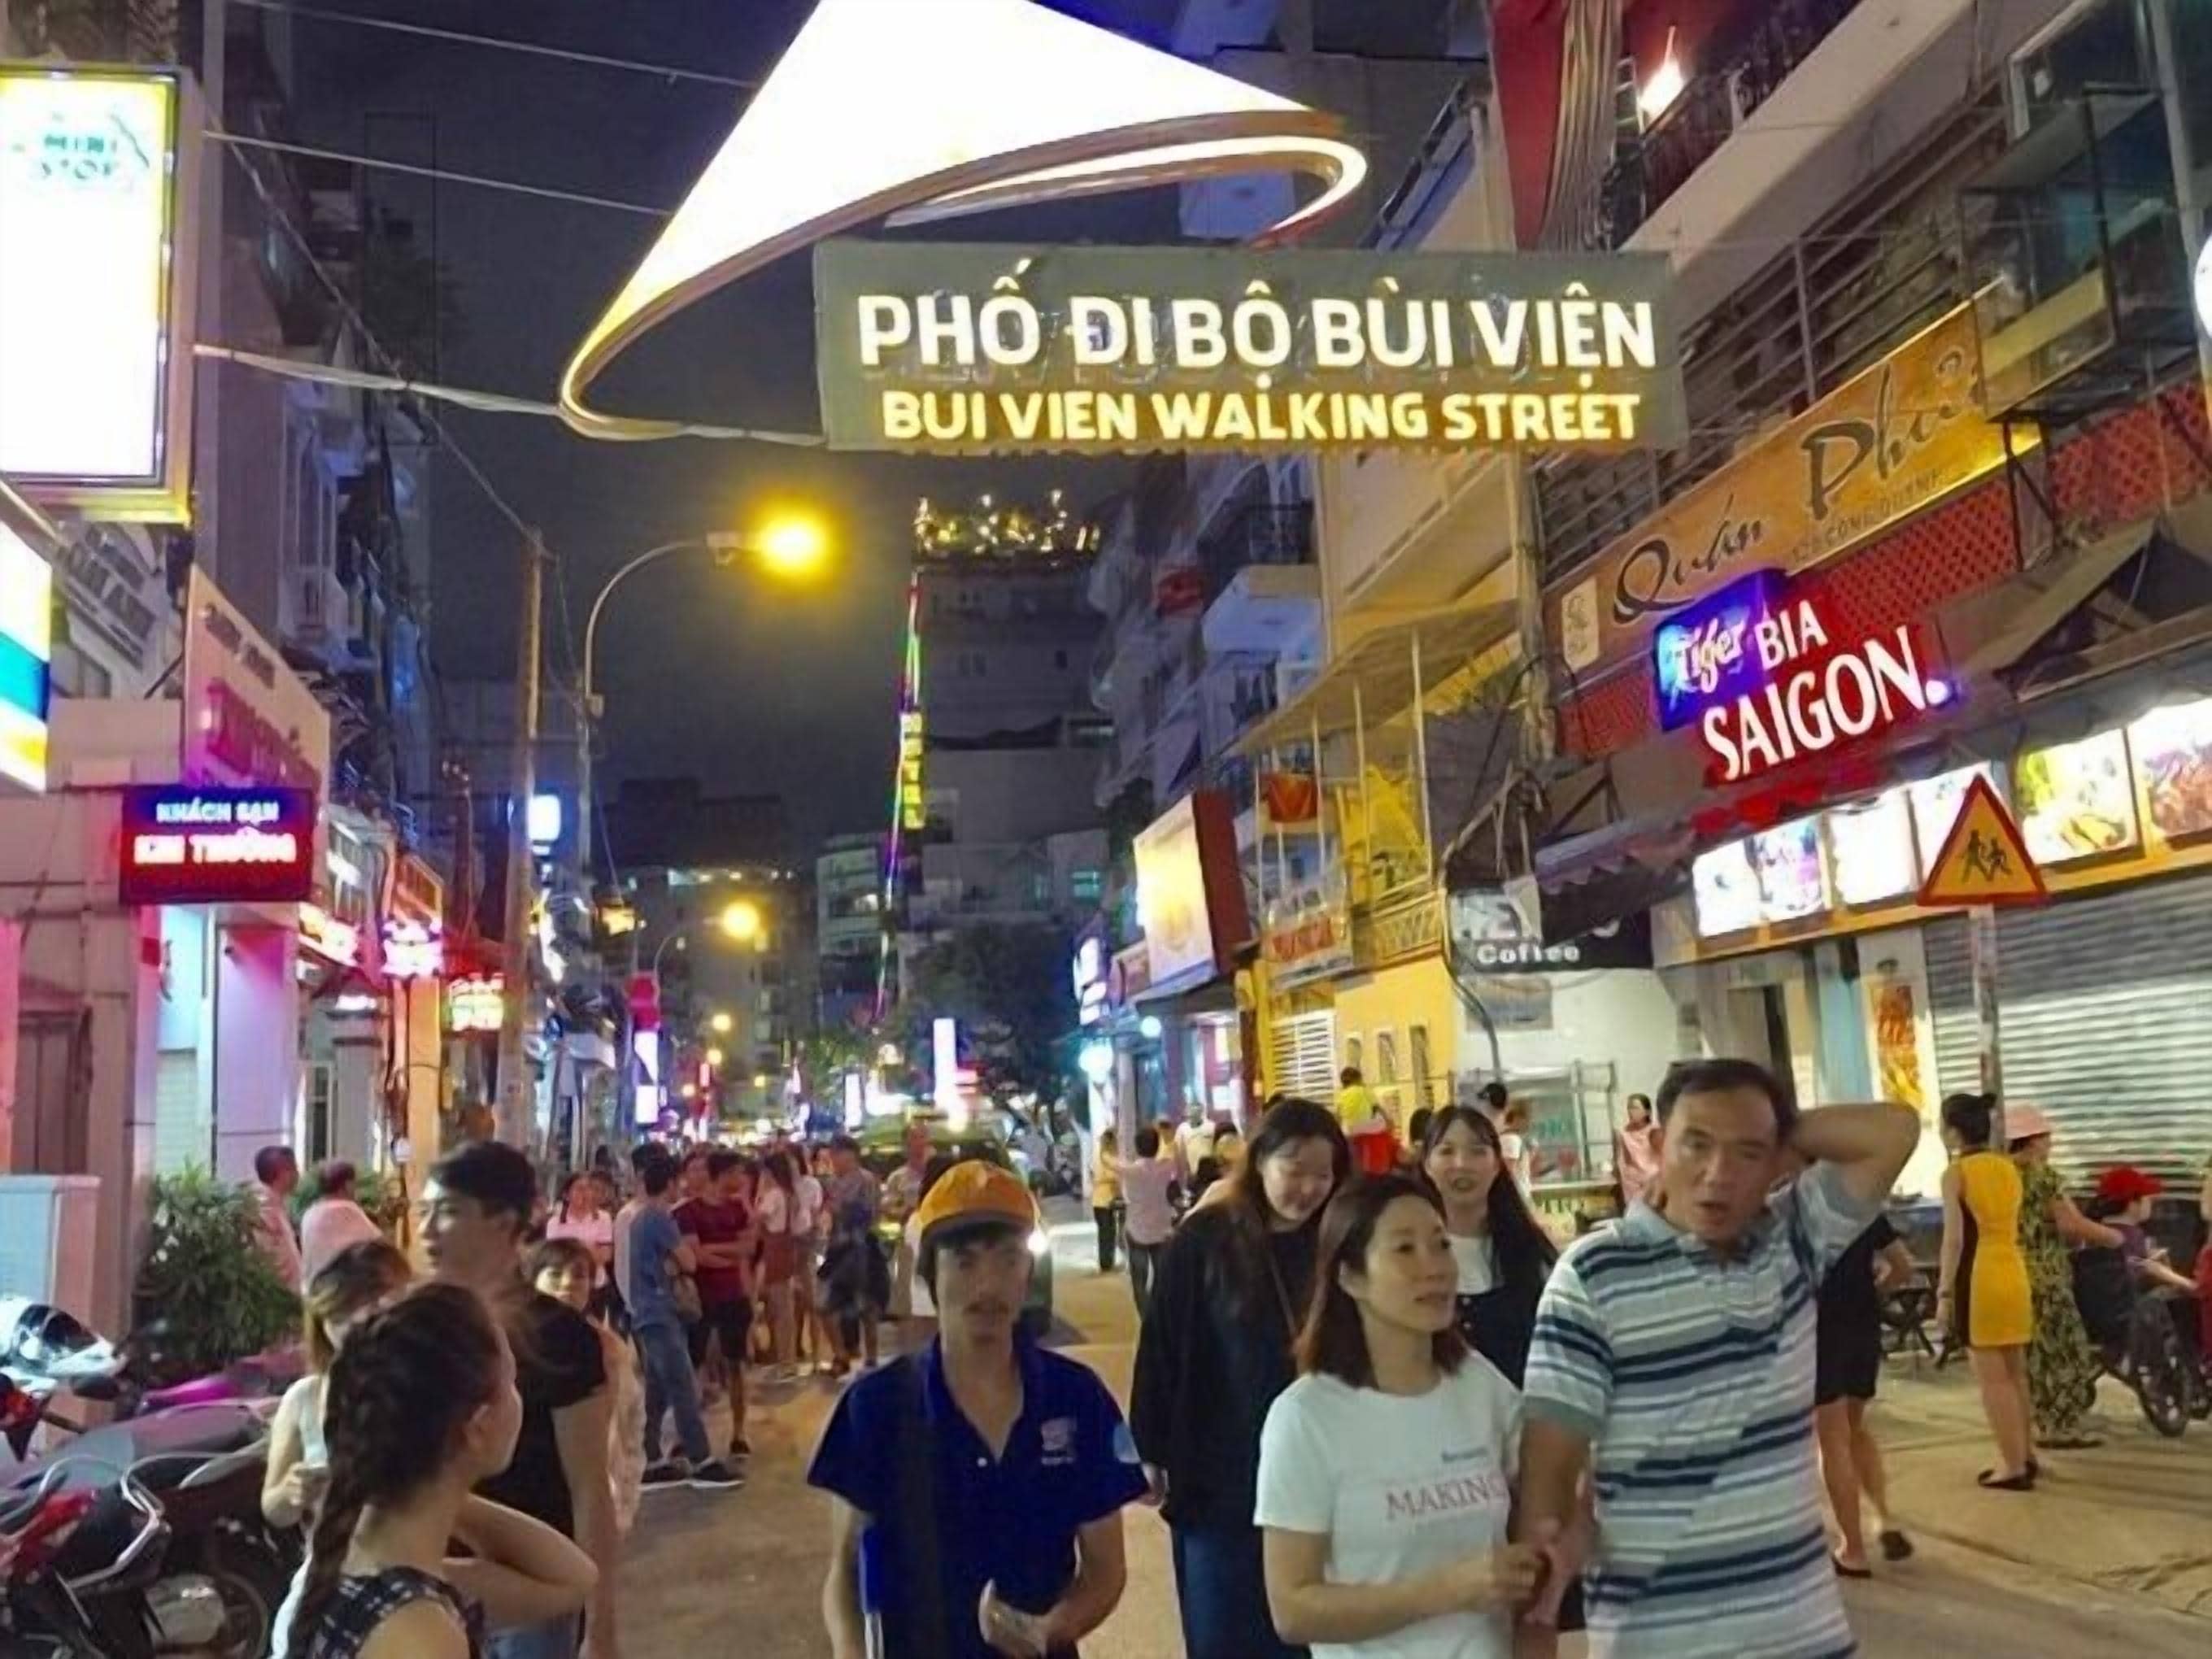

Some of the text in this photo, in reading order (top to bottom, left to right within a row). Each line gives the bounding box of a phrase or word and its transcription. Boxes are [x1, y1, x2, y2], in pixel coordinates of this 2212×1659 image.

[857, 257, 1656, 389] PHỐ ĐI BỘ BÙI VIỆN
[882, 390, 1641, 441] BUI VIEN WALKING STREET
[1754, 599, 1829, 672] BIA
[1476, 942, 1581, 965] Coffee
